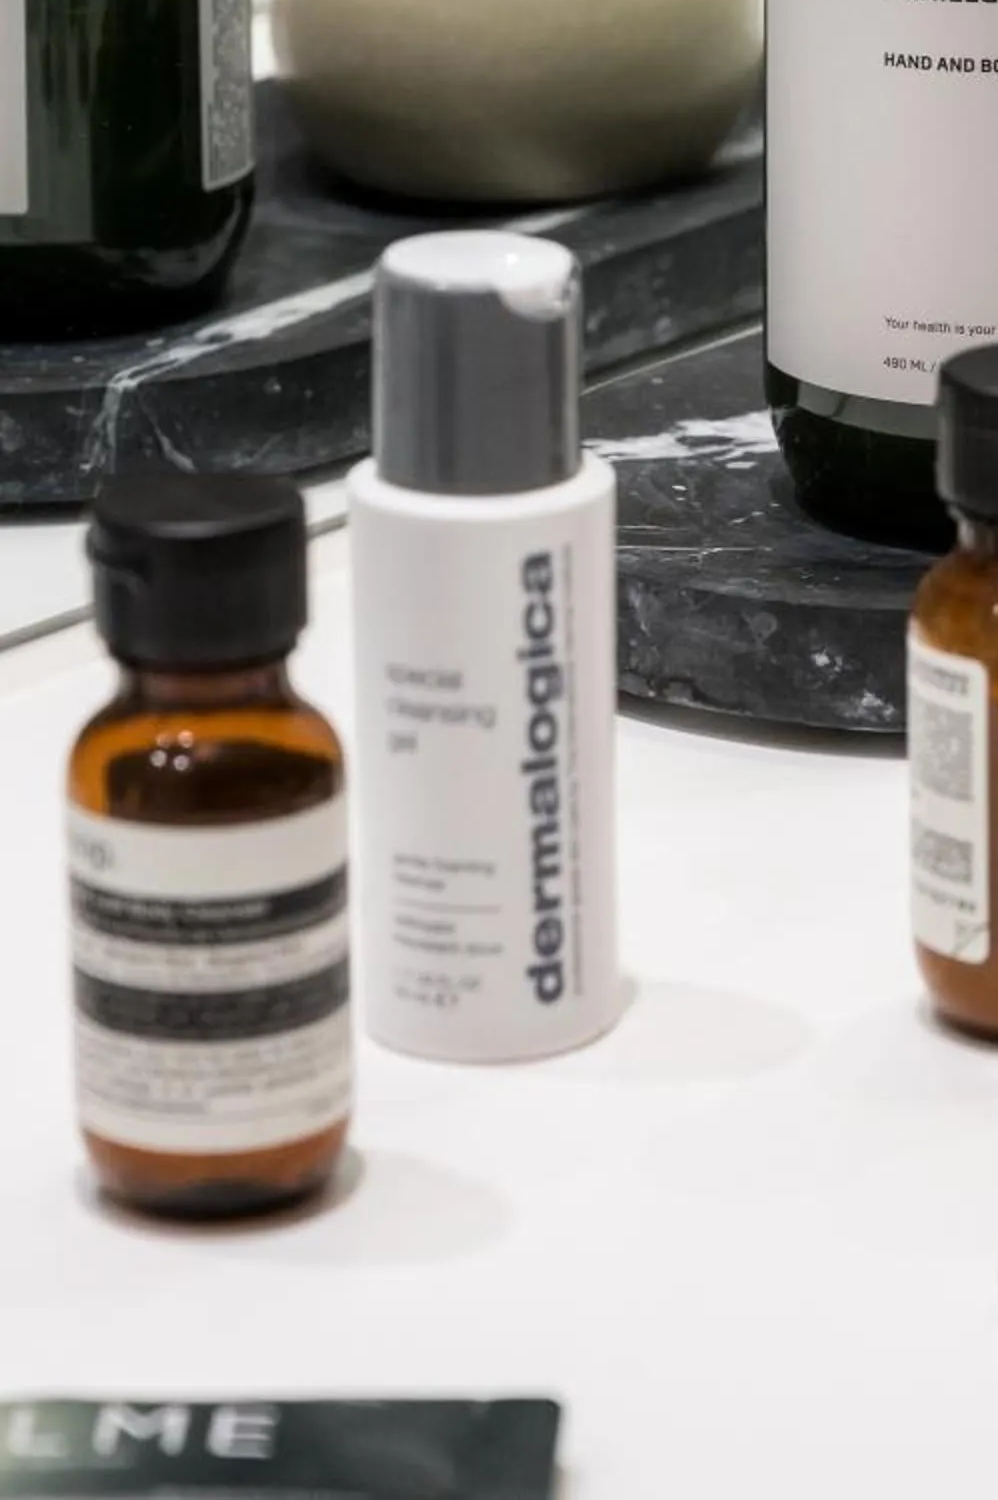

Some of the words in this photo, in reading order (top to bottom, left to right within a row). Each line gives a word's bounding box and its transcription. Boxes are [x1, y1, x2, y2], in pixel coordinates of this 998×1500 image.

[884, 52, 933, 70] HAND
[937, 57, 975, 72] AND
[885, 316, 909, 329] Your
[913, 320, 951, 333] health
[955, 324, 965, 335] is
[969, 325, 996, 337] your
[517, 551, 564, 1004] dermalogica
